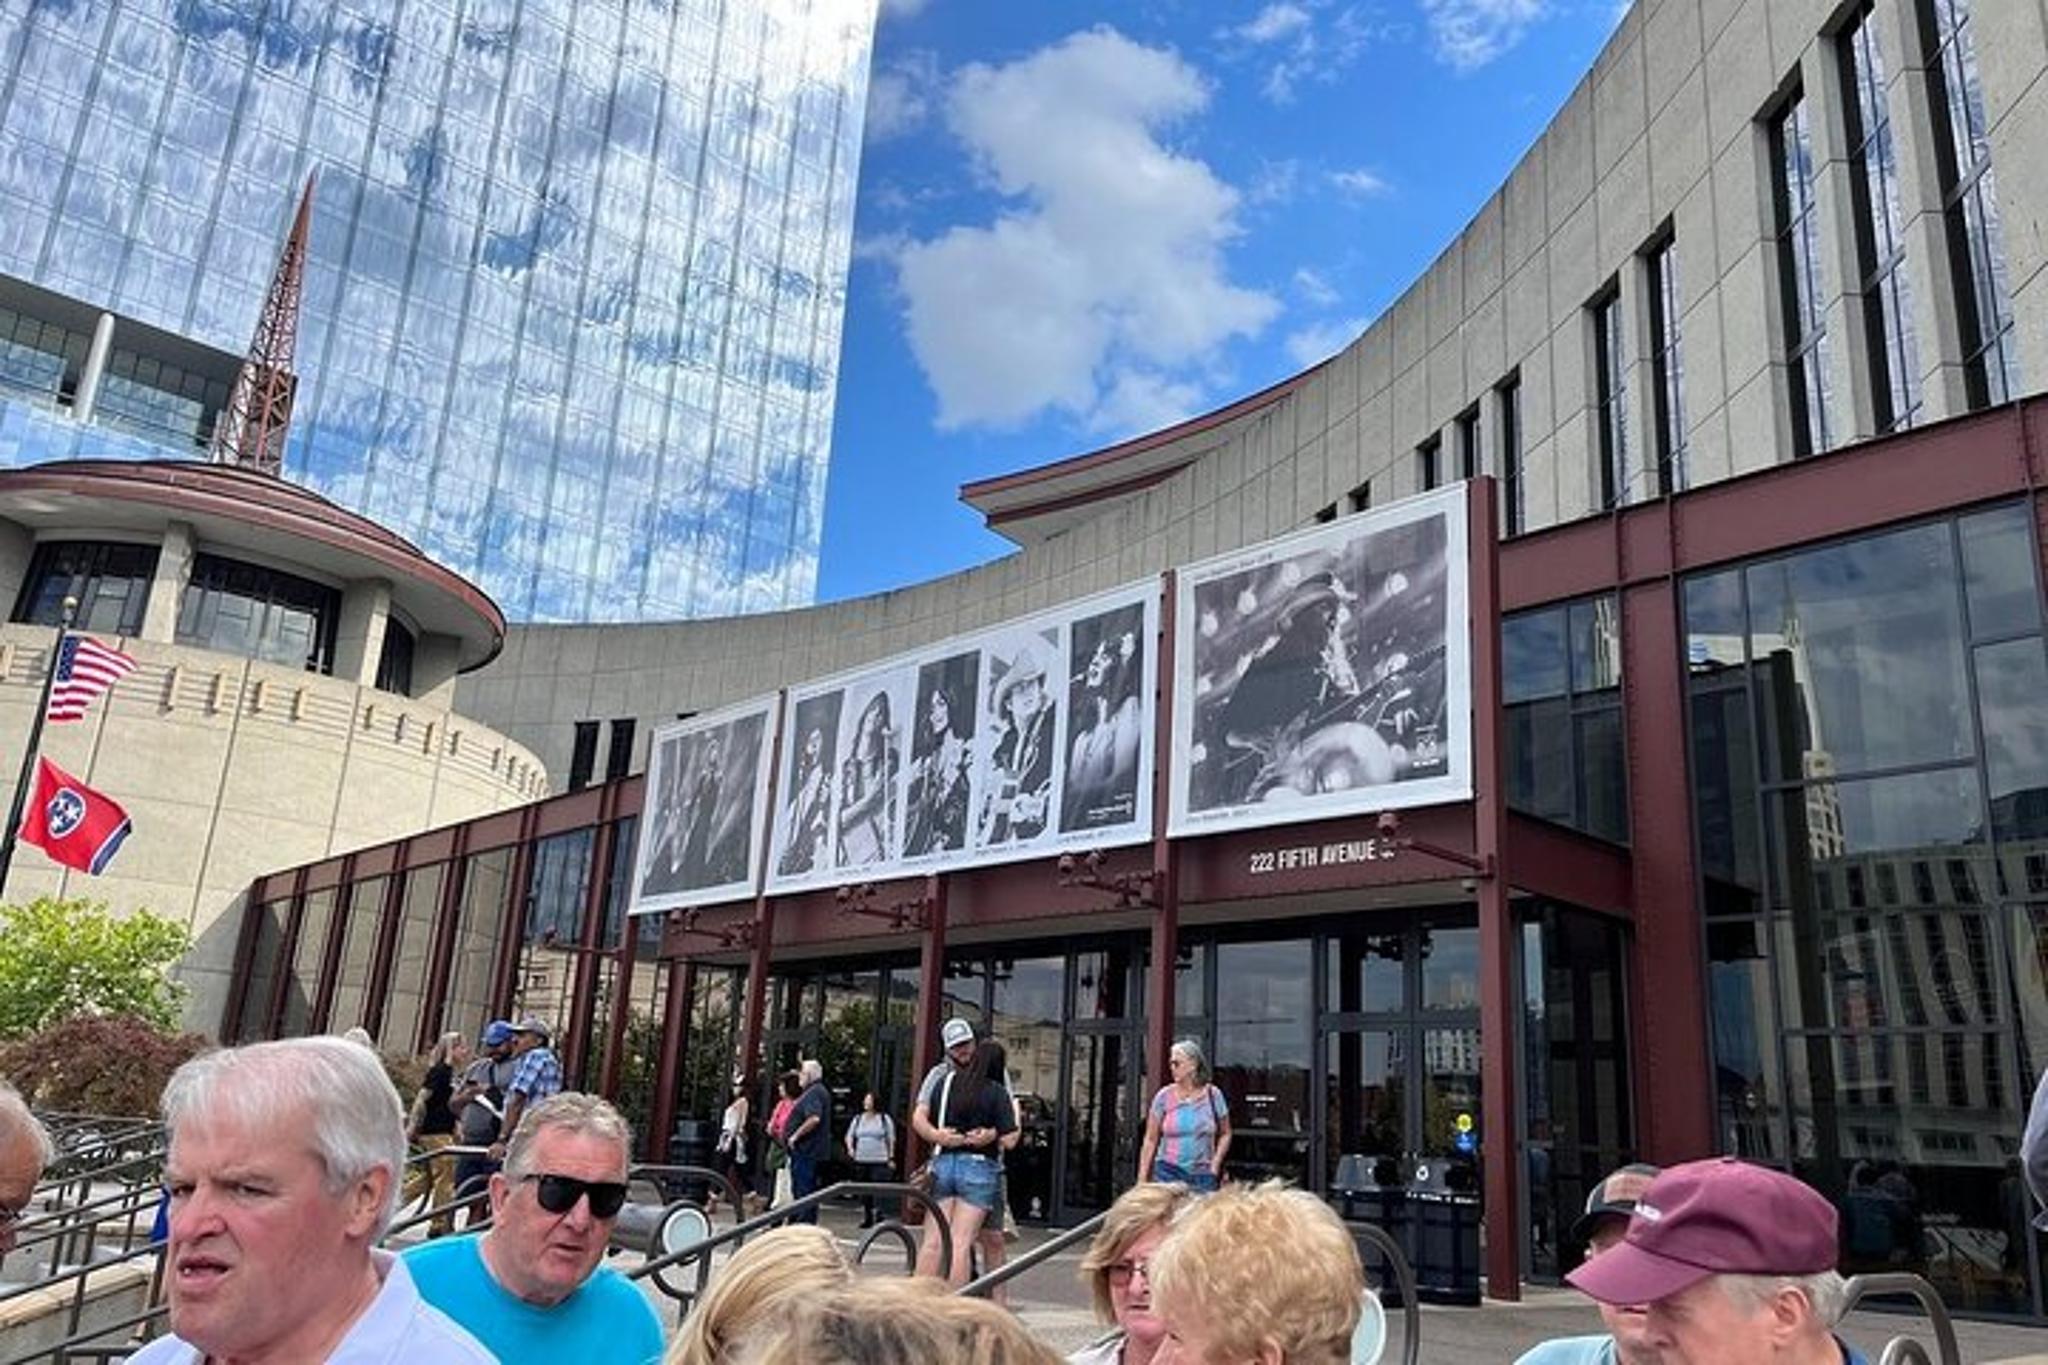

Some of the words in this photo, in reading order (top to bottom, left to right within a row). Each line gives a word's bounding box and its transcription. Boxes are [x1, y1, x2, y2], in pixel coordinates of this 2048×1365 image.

[1250, 852, 1275, 873] 222
[1278, 847, 1318, 869] FIFTH
[1321, 839, 1377, 865] AVENUE
